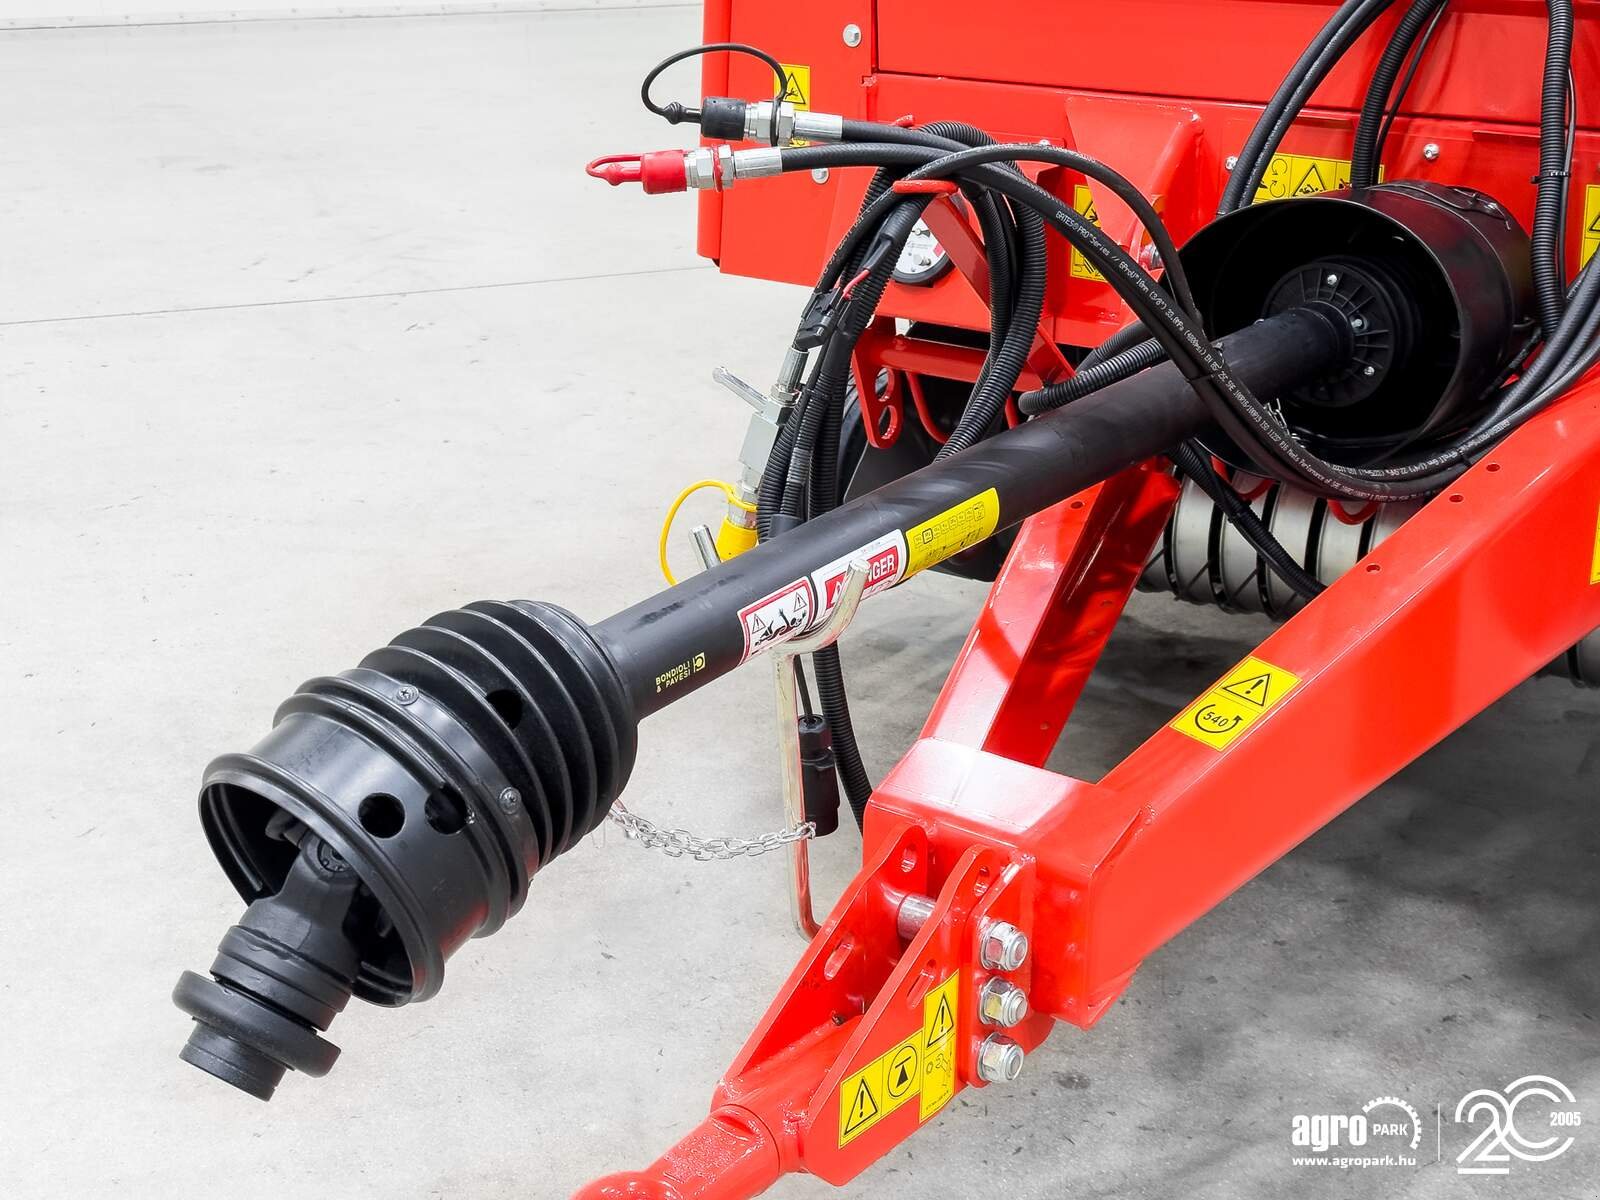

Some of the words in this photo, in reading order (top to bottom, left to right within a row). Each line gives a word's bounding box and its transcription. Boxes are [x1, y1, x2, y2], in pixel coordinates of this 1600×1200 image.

[655, 660, 690, 686] BONDIOLI
[656, 685, 662, 693] &
[665, 669, 691, 688] PAVESI
[1203, 711, 1229, 727] 540
